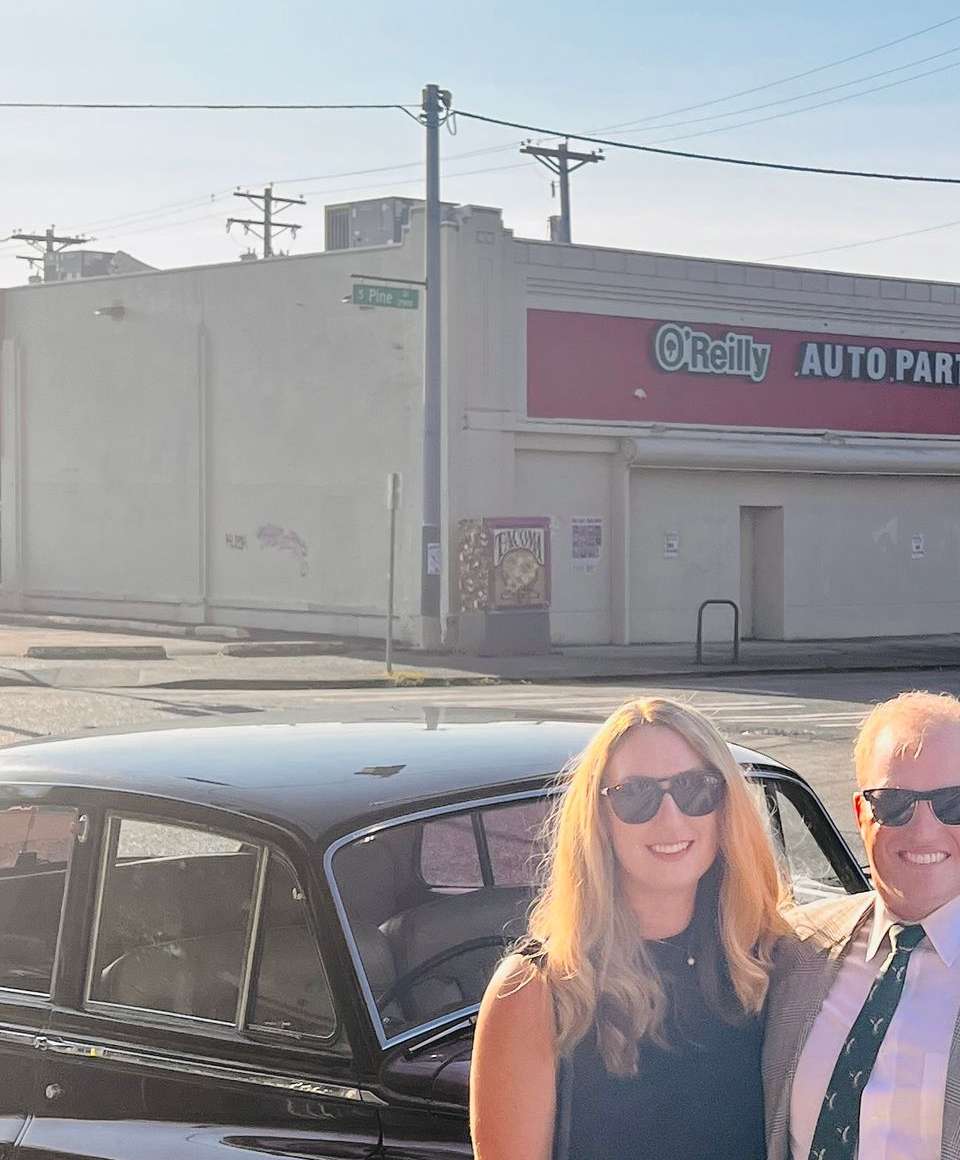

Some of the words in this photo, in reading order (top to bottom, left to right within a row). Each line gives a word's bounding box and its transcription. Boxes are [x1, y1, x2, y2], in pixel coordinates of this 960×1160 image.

[358, 289, 365, 301] S
[368, 288, 393, 304] Pine
[656, 324, 770, 380] O'Reilly
[801, 343, 888, 381] AUTO
[494, 529, 546, 565] TACOMA
